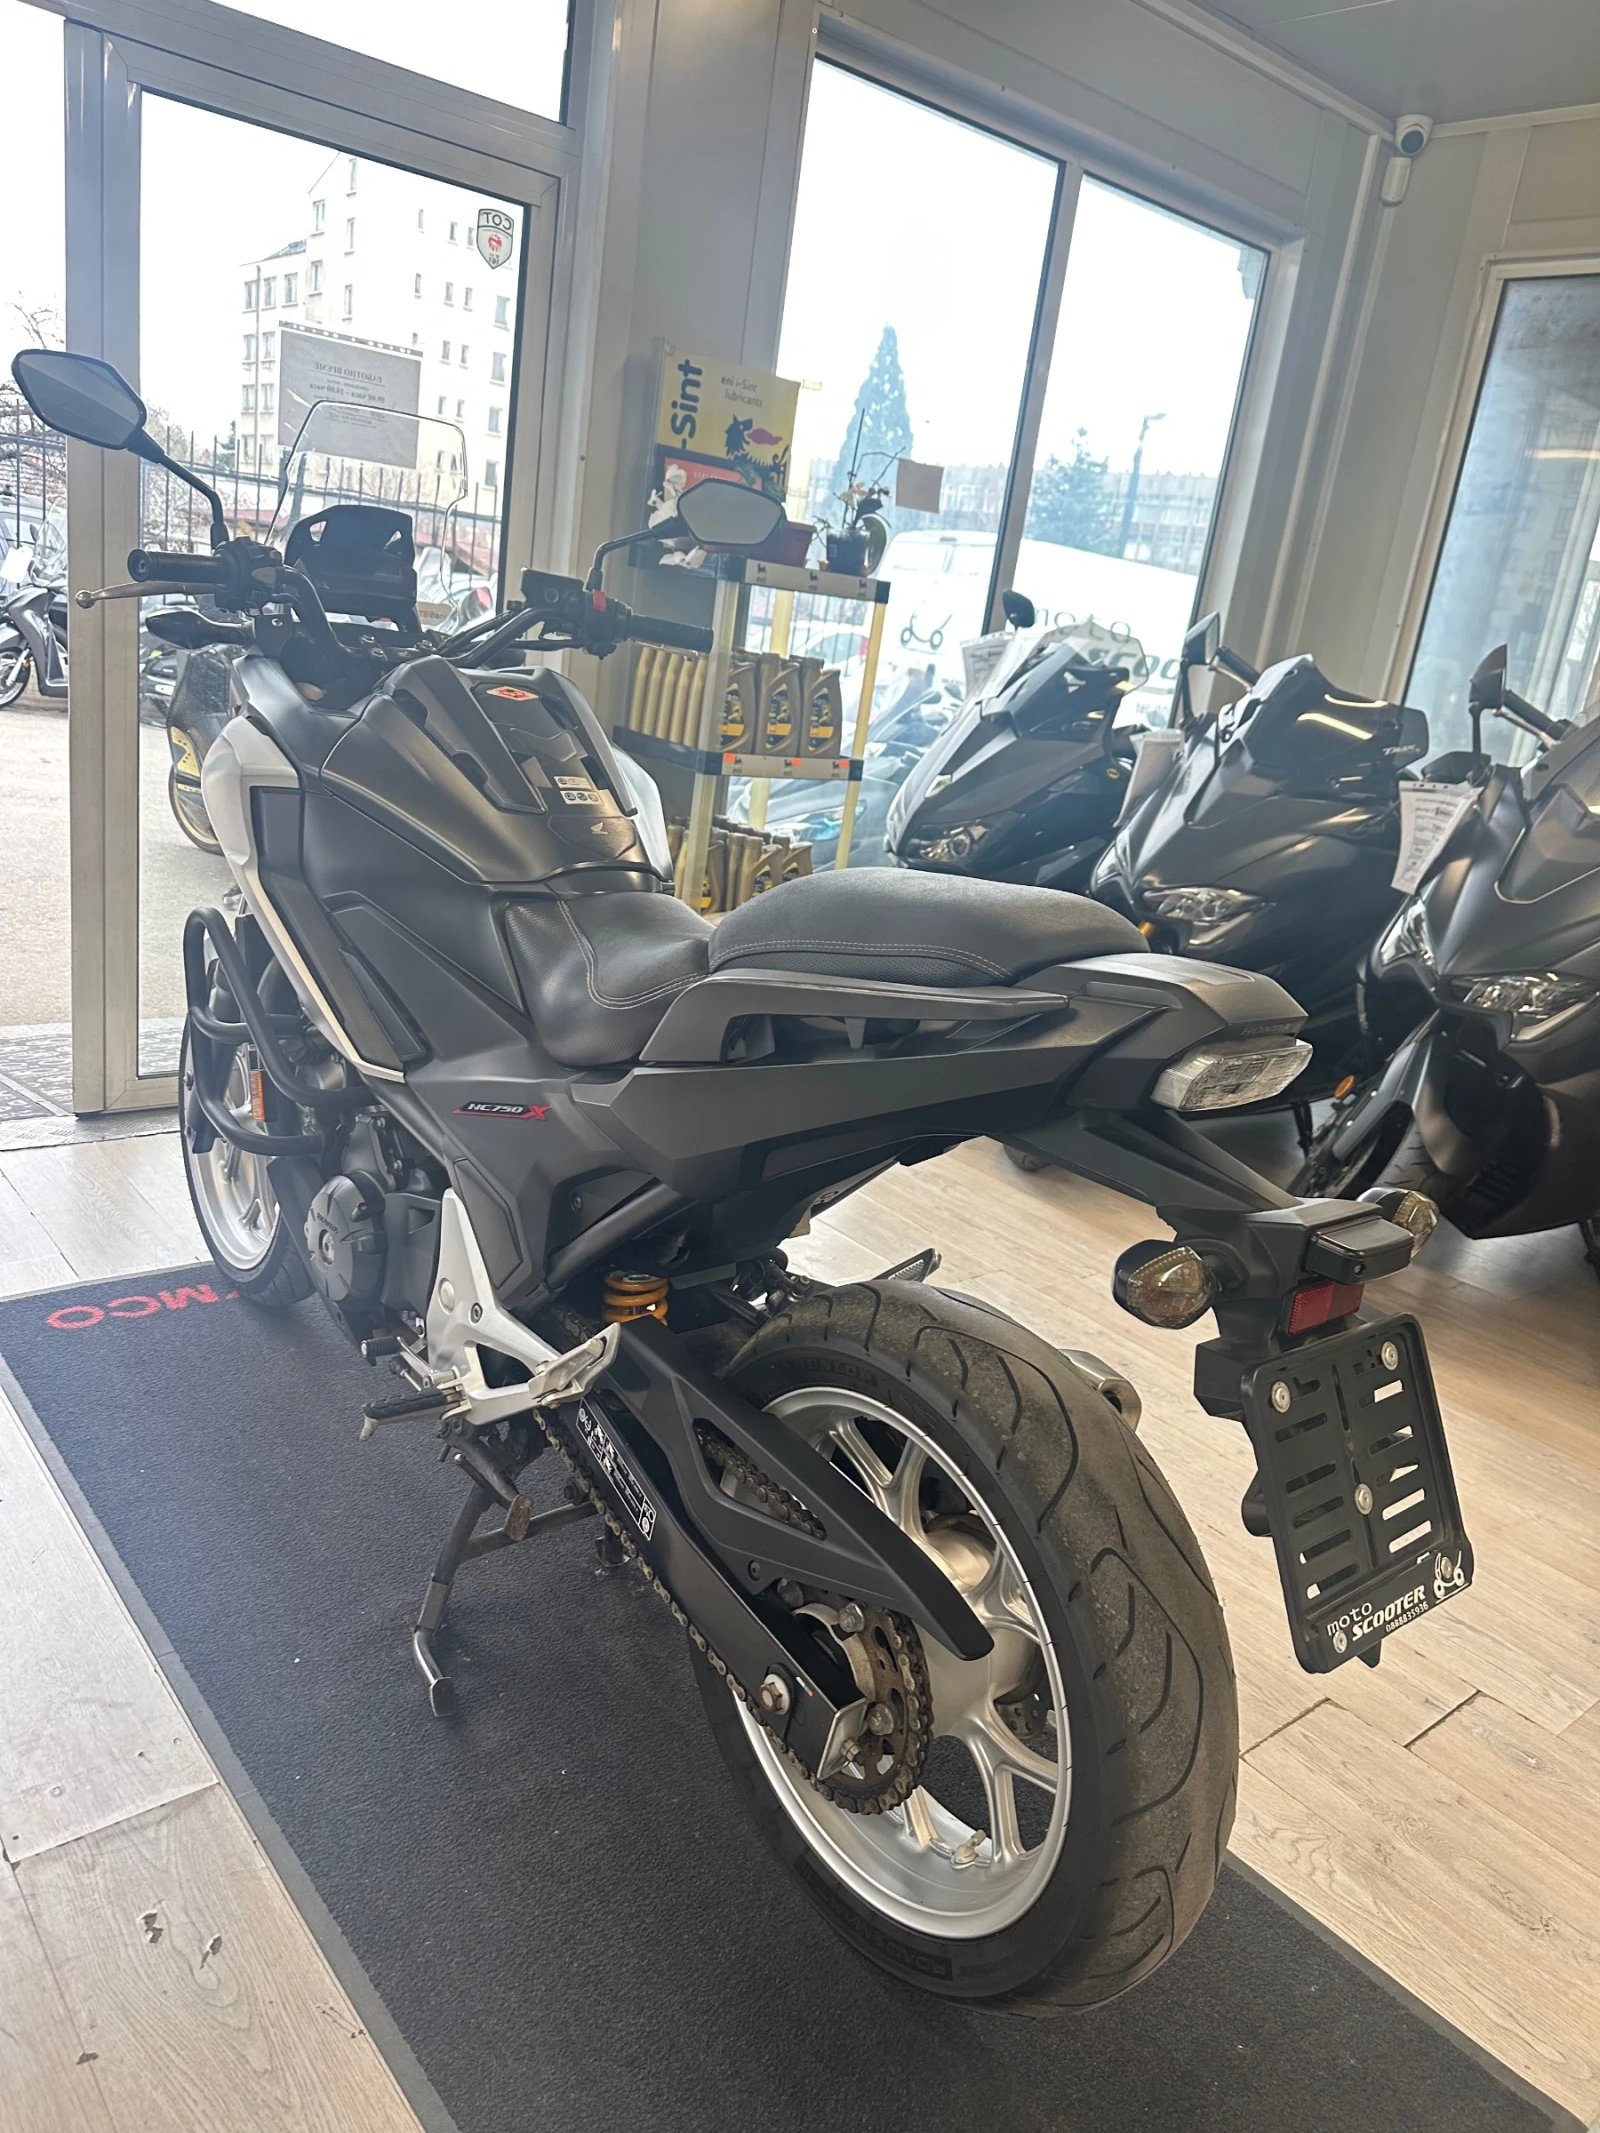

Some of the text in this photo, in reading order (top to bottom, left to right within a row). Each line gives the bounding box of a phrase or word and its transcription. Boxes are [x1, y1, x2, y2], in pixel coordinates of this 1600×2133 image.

[721, 376, 757, 392] eni i-Sint
[724, 388, 763, 408] lubricants
[1327, 1602, 1372, 1636] moto
[1352, 1584, 1426, 1642] SCOOTER
